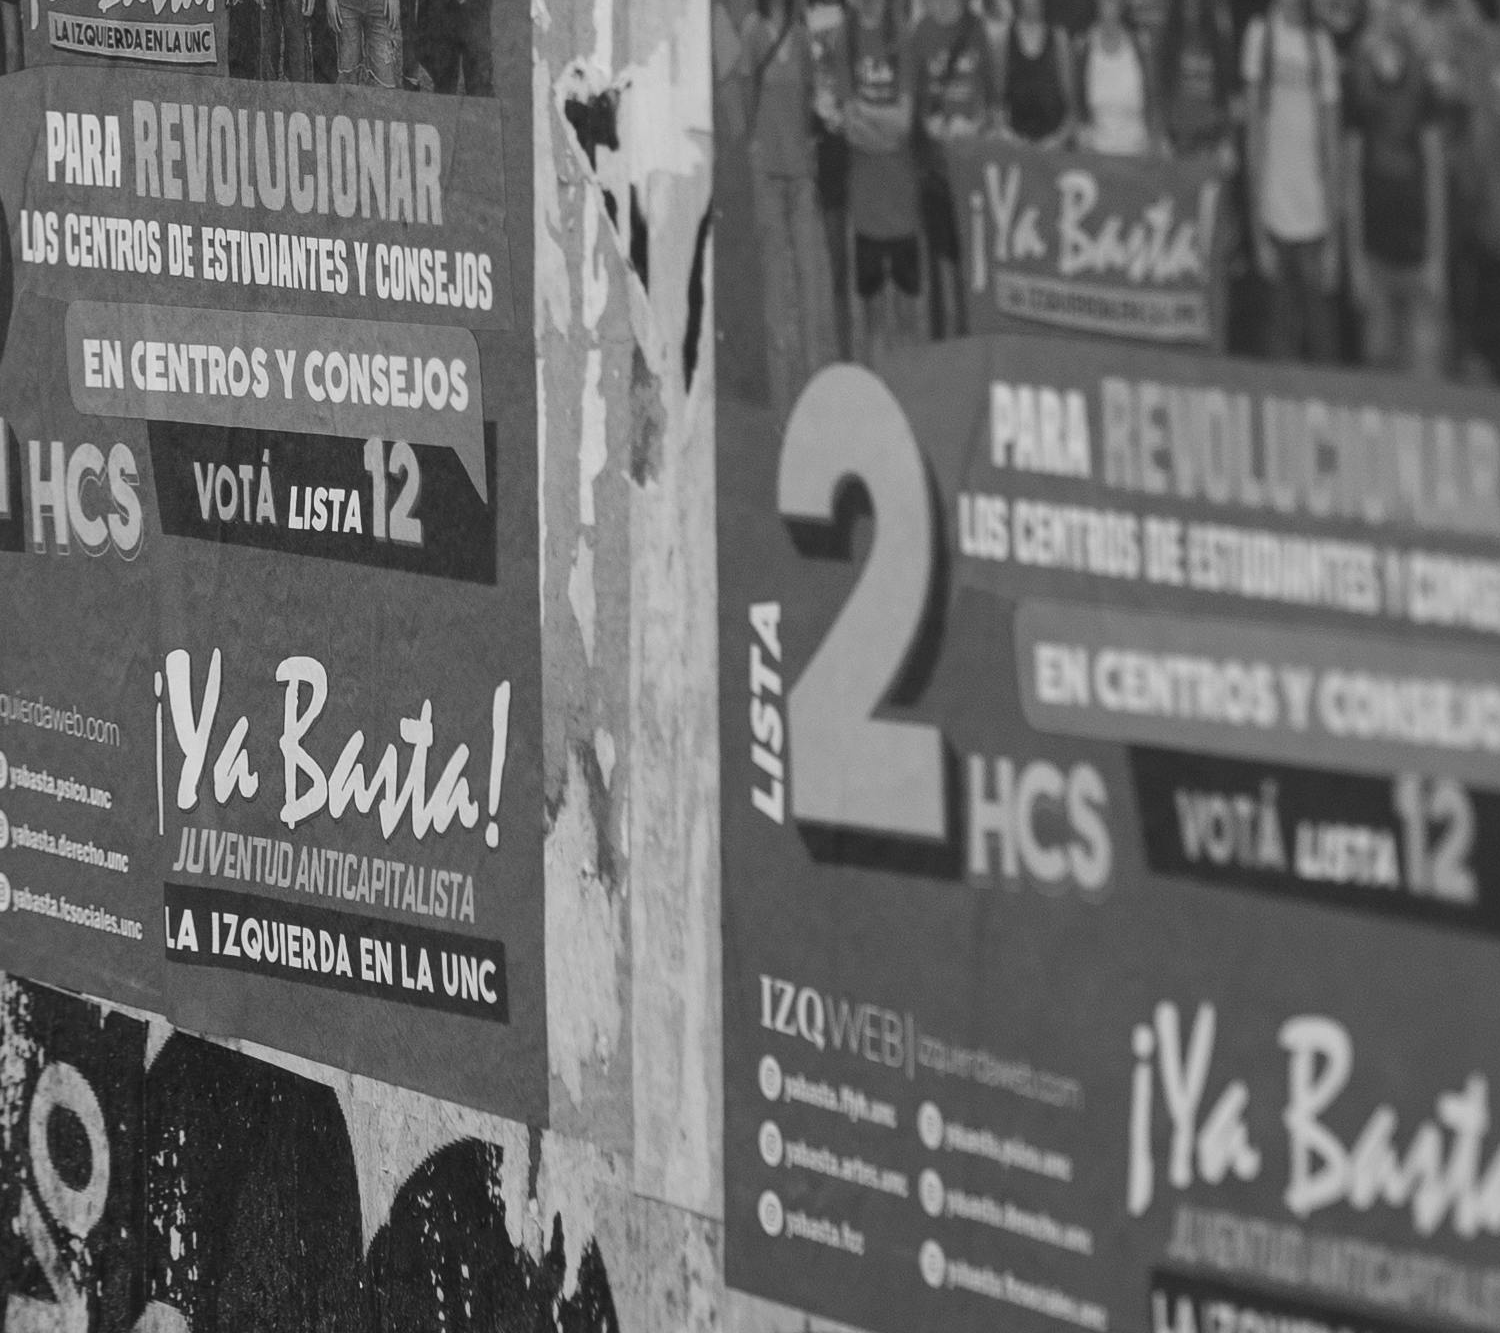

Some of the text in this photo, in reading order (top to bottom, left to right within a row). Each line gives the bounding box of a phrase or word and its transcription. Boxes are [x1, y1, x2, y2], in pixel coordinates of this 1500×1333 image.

[71, 25, 144, 54] IZQUIERDA
[185, 30, 211, 53] UNC
[46, 100, 443, 226] PARA REVOLUCIONAR
[20, 209, 492, 311] LOS CENTROS DE ESTUDIANTES Y CONSEJOS
[83, 339, 468, 412] EN CENTROS Y CONSEJOS
[990, 381, 1089, 480] PARA
[28, 440, 143, 553] HCS
[193, 436, 422, 545] VOTÁ LISTA 12
[777, 362, 946, 842] 2
[749, 601, 783, 825] LISTA
[1034, 643, 1089, 706] EN
[1096, 649, 1275, 726] CENTROS
[1281, 665, 1315, 727] Y
[275, 656, 511, 848] Basta!
[173, 826, 475, 924] JUVENTUD ANTICAPITALISTA
[967, 753, 1111, 892] HCS
[1392, 771, 1477, 904] 12
[165, 904, 497, 1004] LA IZQUIERDA EN LA UNC
